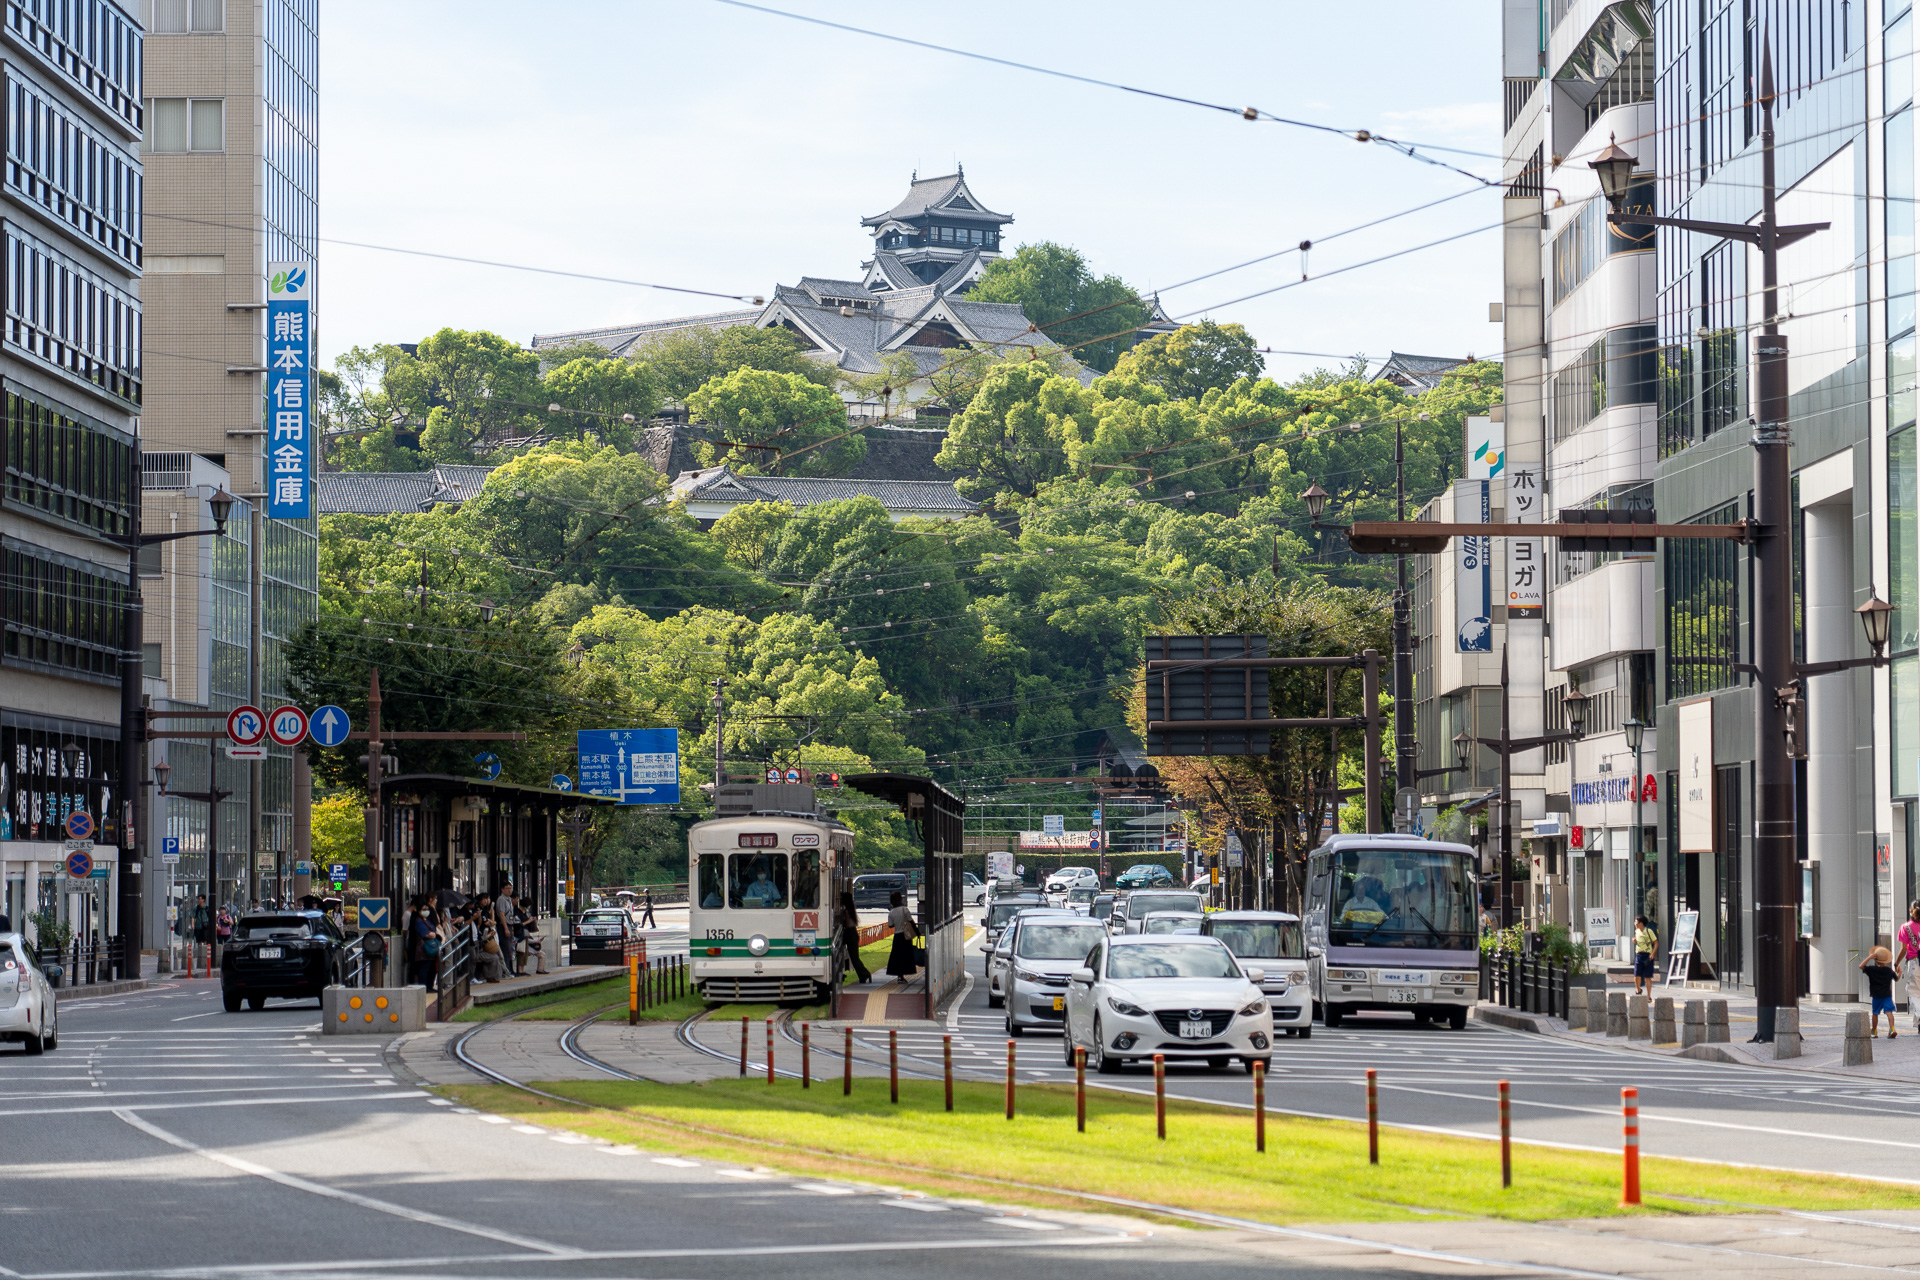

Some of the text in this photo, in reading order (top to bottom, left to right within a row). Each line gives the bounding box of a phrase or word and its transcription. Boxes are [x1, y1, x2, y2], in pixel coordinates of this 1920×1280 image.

[274, 311, 303, 506] 熊本信用金庫
[277, 717, 299, 734] 40
[610, 731, 632, 740] 植木
[581, 754, 610, 764] 熊本駅
[635, 754, 673, 764] 上熊本駅
[582, 771, 611, 780] 熊本城
[166, 839, 177, 853] P
[741, 836, 774, 847] 健軍町
[333, 865, 344, 873] P
[800, 914, 813, 926] A
[706, 929, 734, 940] 1356
